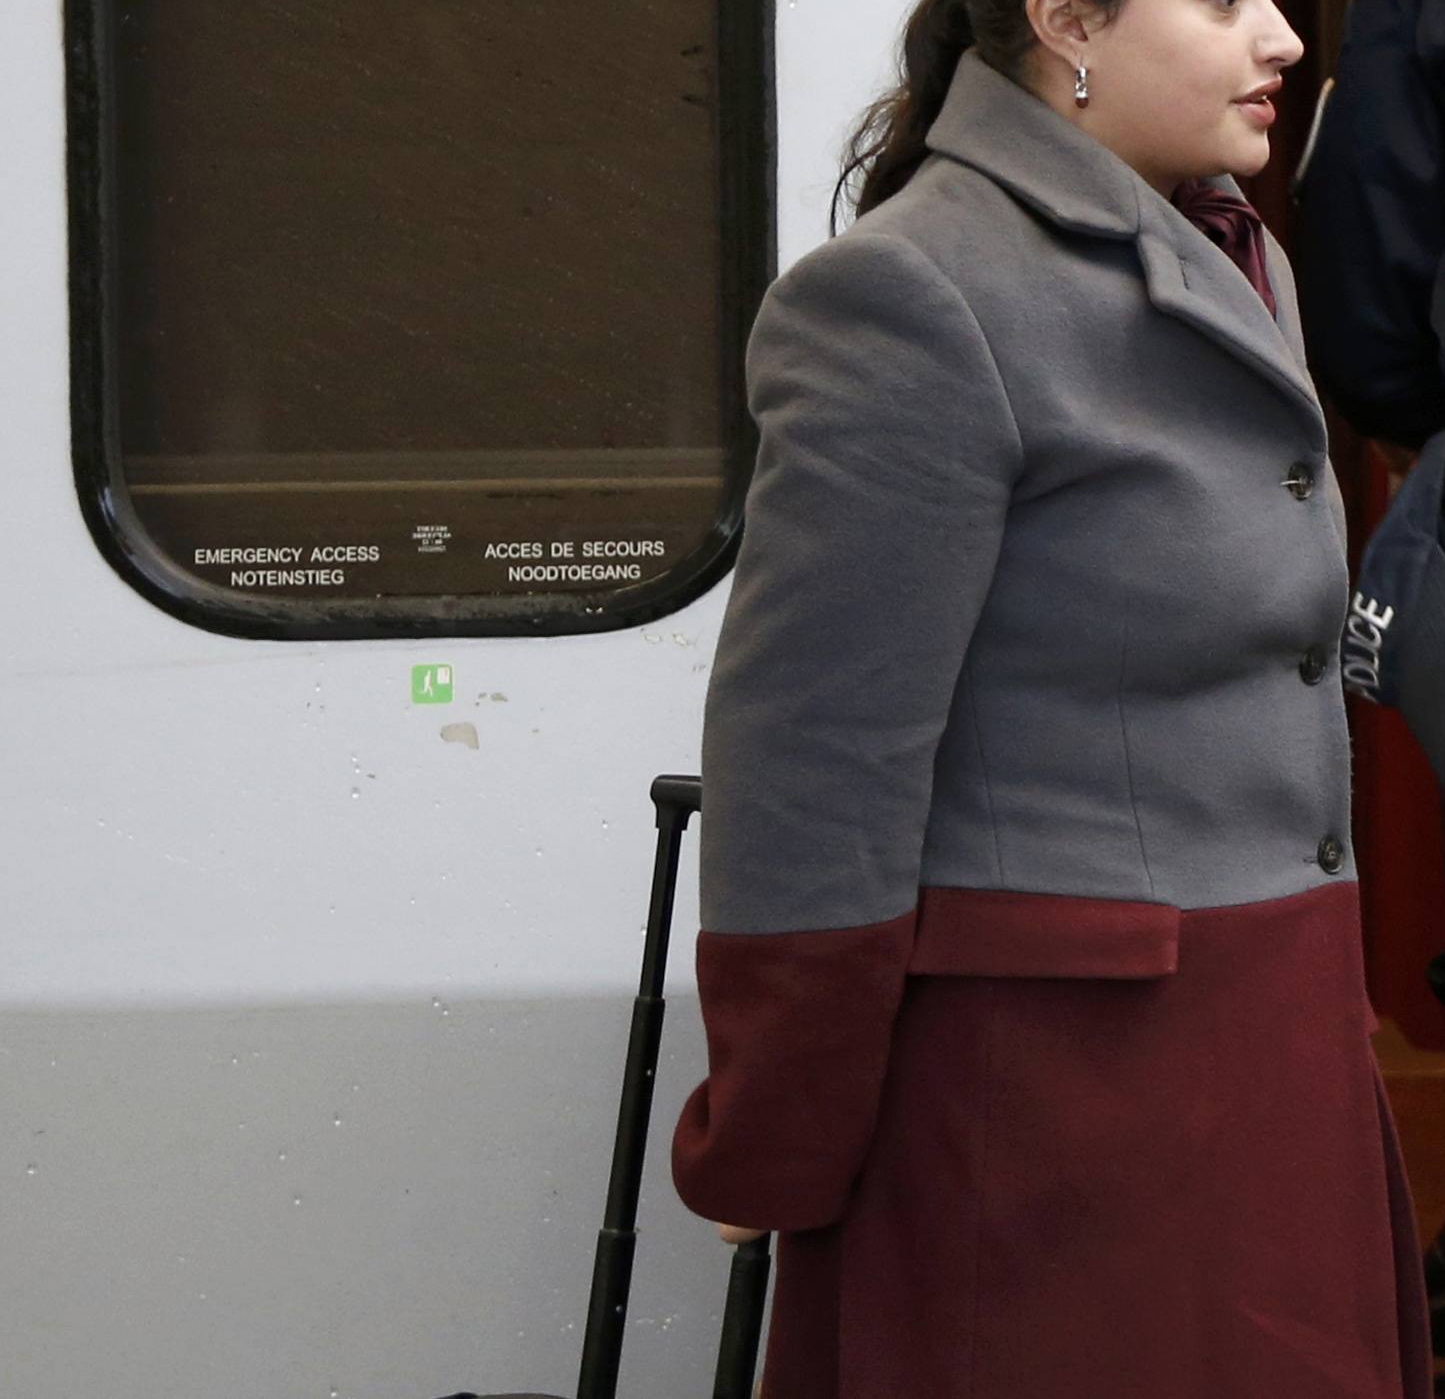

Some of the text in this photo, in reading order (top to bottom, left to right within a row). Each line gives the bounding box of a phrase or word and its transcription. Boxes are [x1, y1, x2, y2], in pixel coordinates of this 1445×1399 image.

[195, 546, 380, 564] EMERGENCY ACCESS
[485, 540, 665, 559] ACCES DE SECOURS
[231, 569, 345, 586] NOTEINSTIEG
[508, 564, 641, 582] NOODTOEGANG
